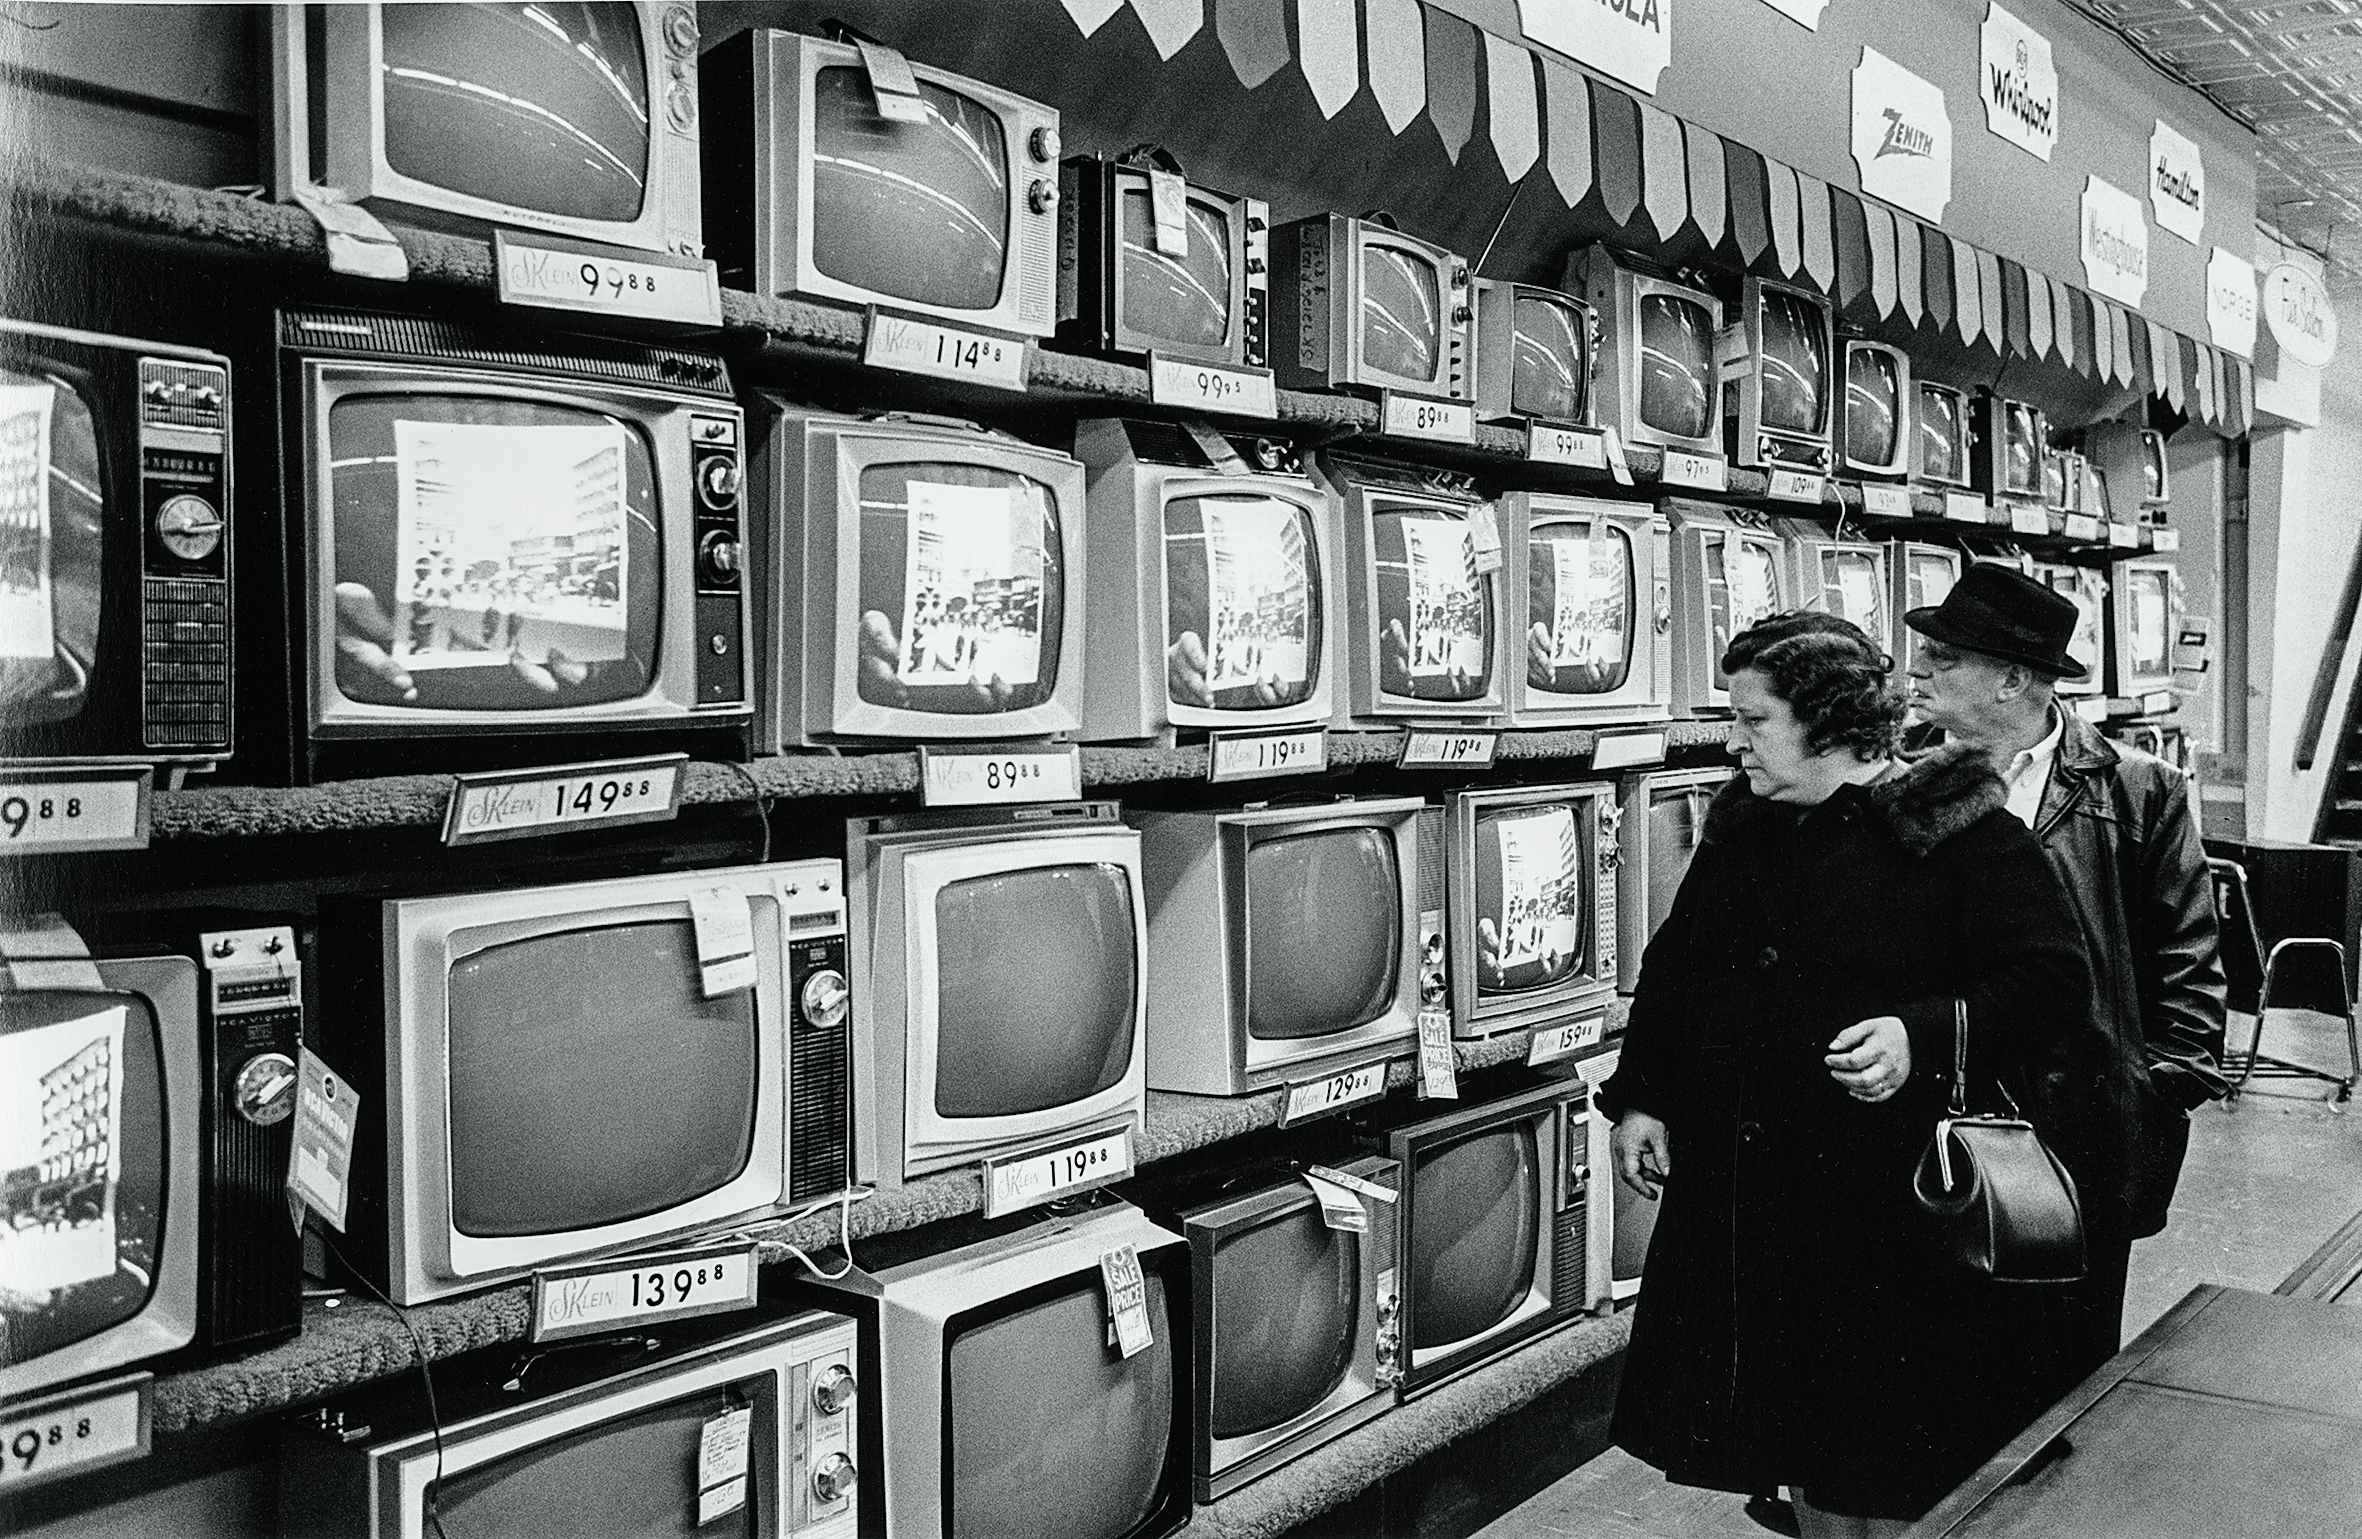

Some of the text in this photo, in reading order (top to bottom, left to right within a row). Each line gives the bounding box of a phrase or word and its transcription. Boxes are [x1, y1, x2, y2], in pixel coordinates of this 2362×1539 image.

[1989, 62, 2052, 137] Whirlpool
[1873, 107, 1934, 160] ZENITH
[2156, 155, 2199, 212] Hamilton
[2087, 206, 2144, 279] Westinghouse
[2213, 284, 2252, 322] NORGE
[1424, 1030, 1446, 1047] SALE
[1425, 1046, 1450, 1064] PRICE
[1111, 1262, 1139, 1291] SALE
[1114, 1283, 1143, 1313] PRICE
